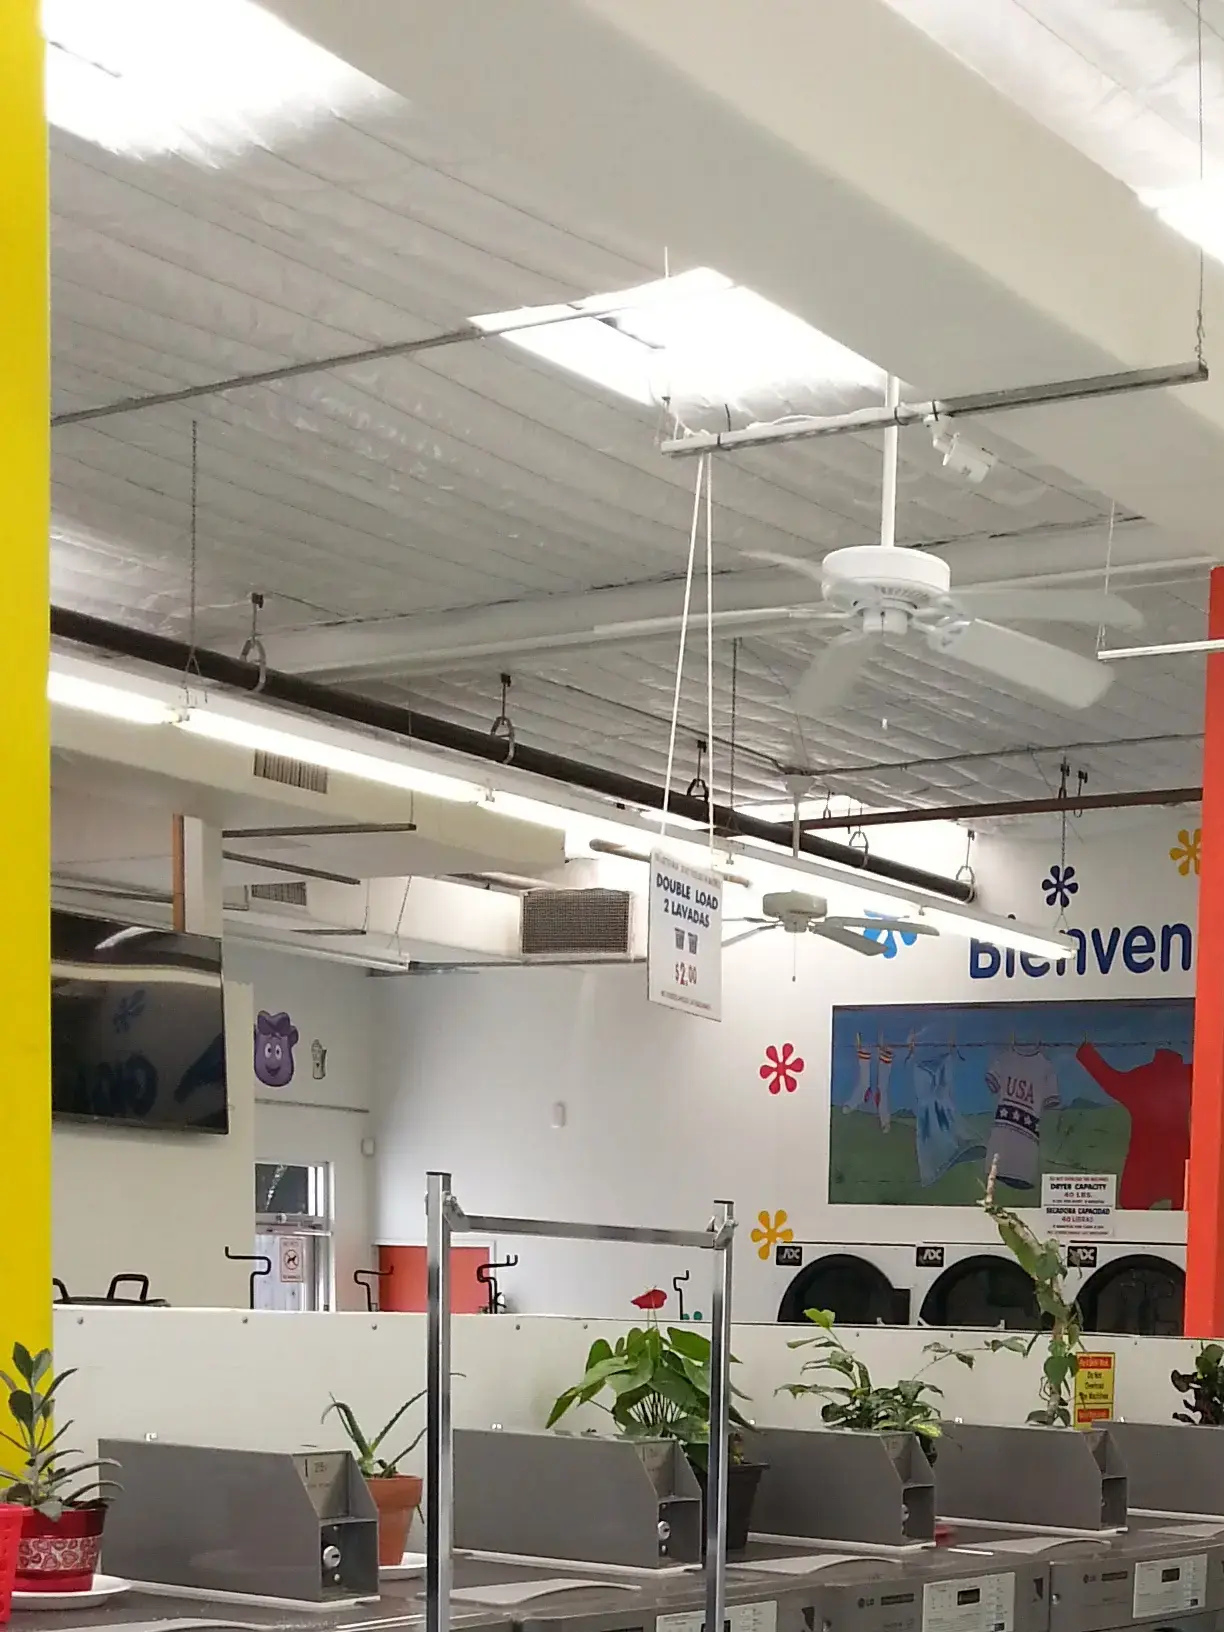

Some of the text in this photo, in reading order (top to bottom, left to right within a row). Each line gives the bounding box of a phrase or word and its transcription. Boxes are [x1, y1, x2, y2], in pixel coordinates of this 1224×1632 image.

[656, 873, 691, 900] DOUBLE
[695, 890, 719, 911] LOAD
[663, 898, 710, 928] 2 LAVADAS
[1006, 1076, 1035, 1104] USA
